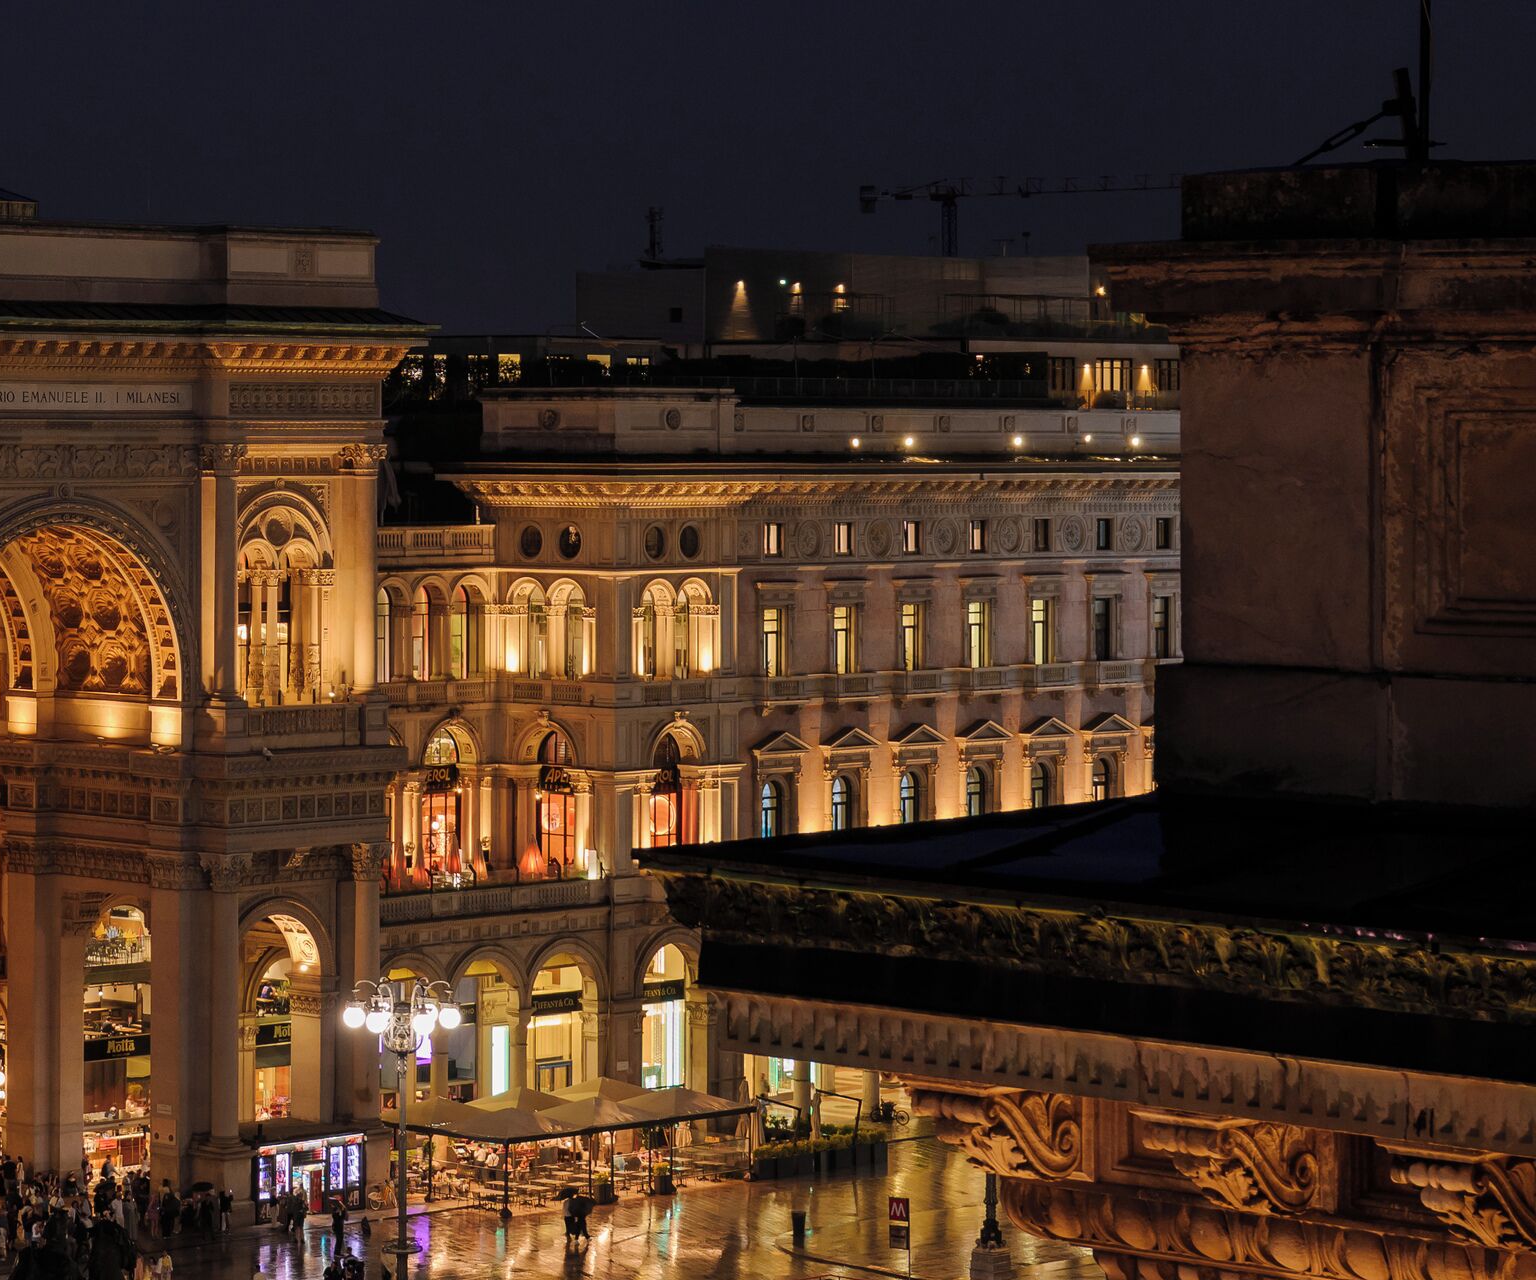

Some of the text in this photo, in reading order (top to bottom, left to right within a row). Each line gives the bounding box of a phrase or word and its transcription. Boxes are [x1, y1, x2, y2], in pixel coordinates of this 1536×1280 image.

[22, 391, 89, 403] EMANUELE
[126, 391, 180, 404] MILANESI
[426, 768, 451, 782] EROL
[655, 769, 674, 784] ROL
[106, 1038, 135, 1054] Motta
[890, 1201, 907, 1218] M
